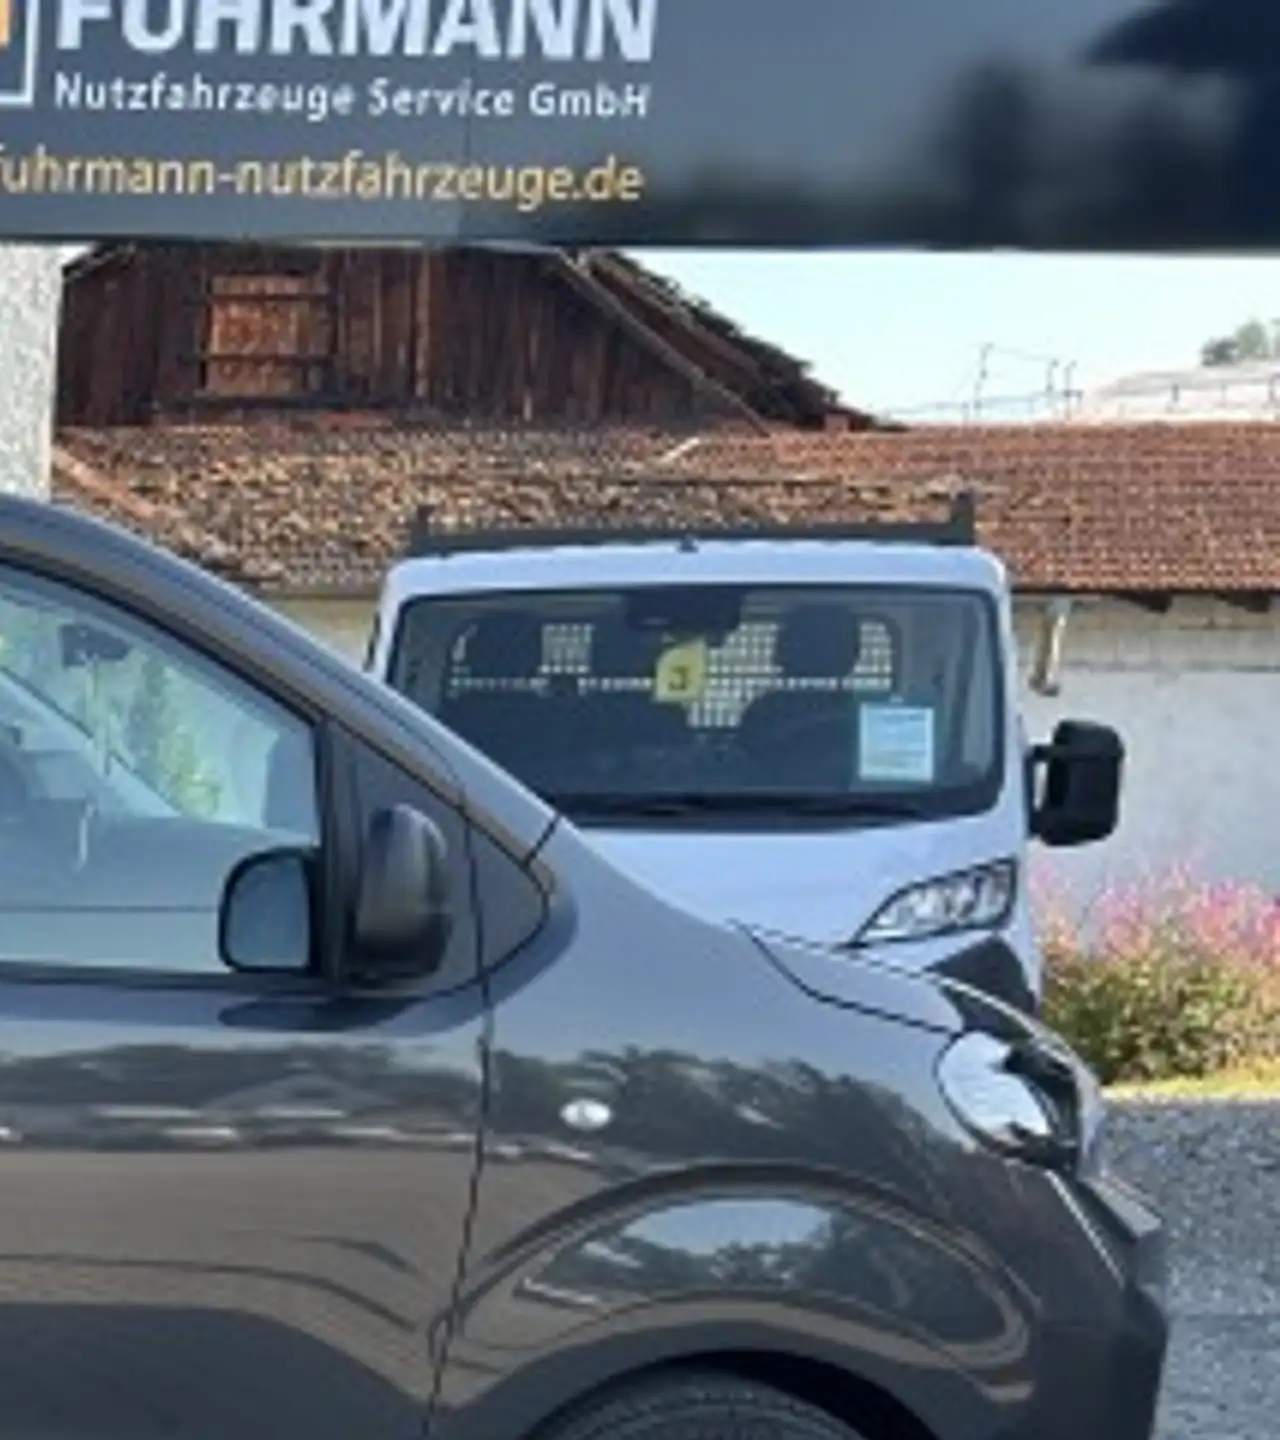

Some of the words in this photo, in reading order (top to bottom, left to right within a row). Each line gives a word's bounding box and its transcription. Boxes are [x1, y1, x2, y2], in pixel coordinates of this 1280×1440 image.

[54, 0, 659, 62] FUHRMANN
[53, 70, 354, 122] Nutzfahrzeuge
[366, 76, 516, 118] Service
[528, 81, 653, 118] GmbH
